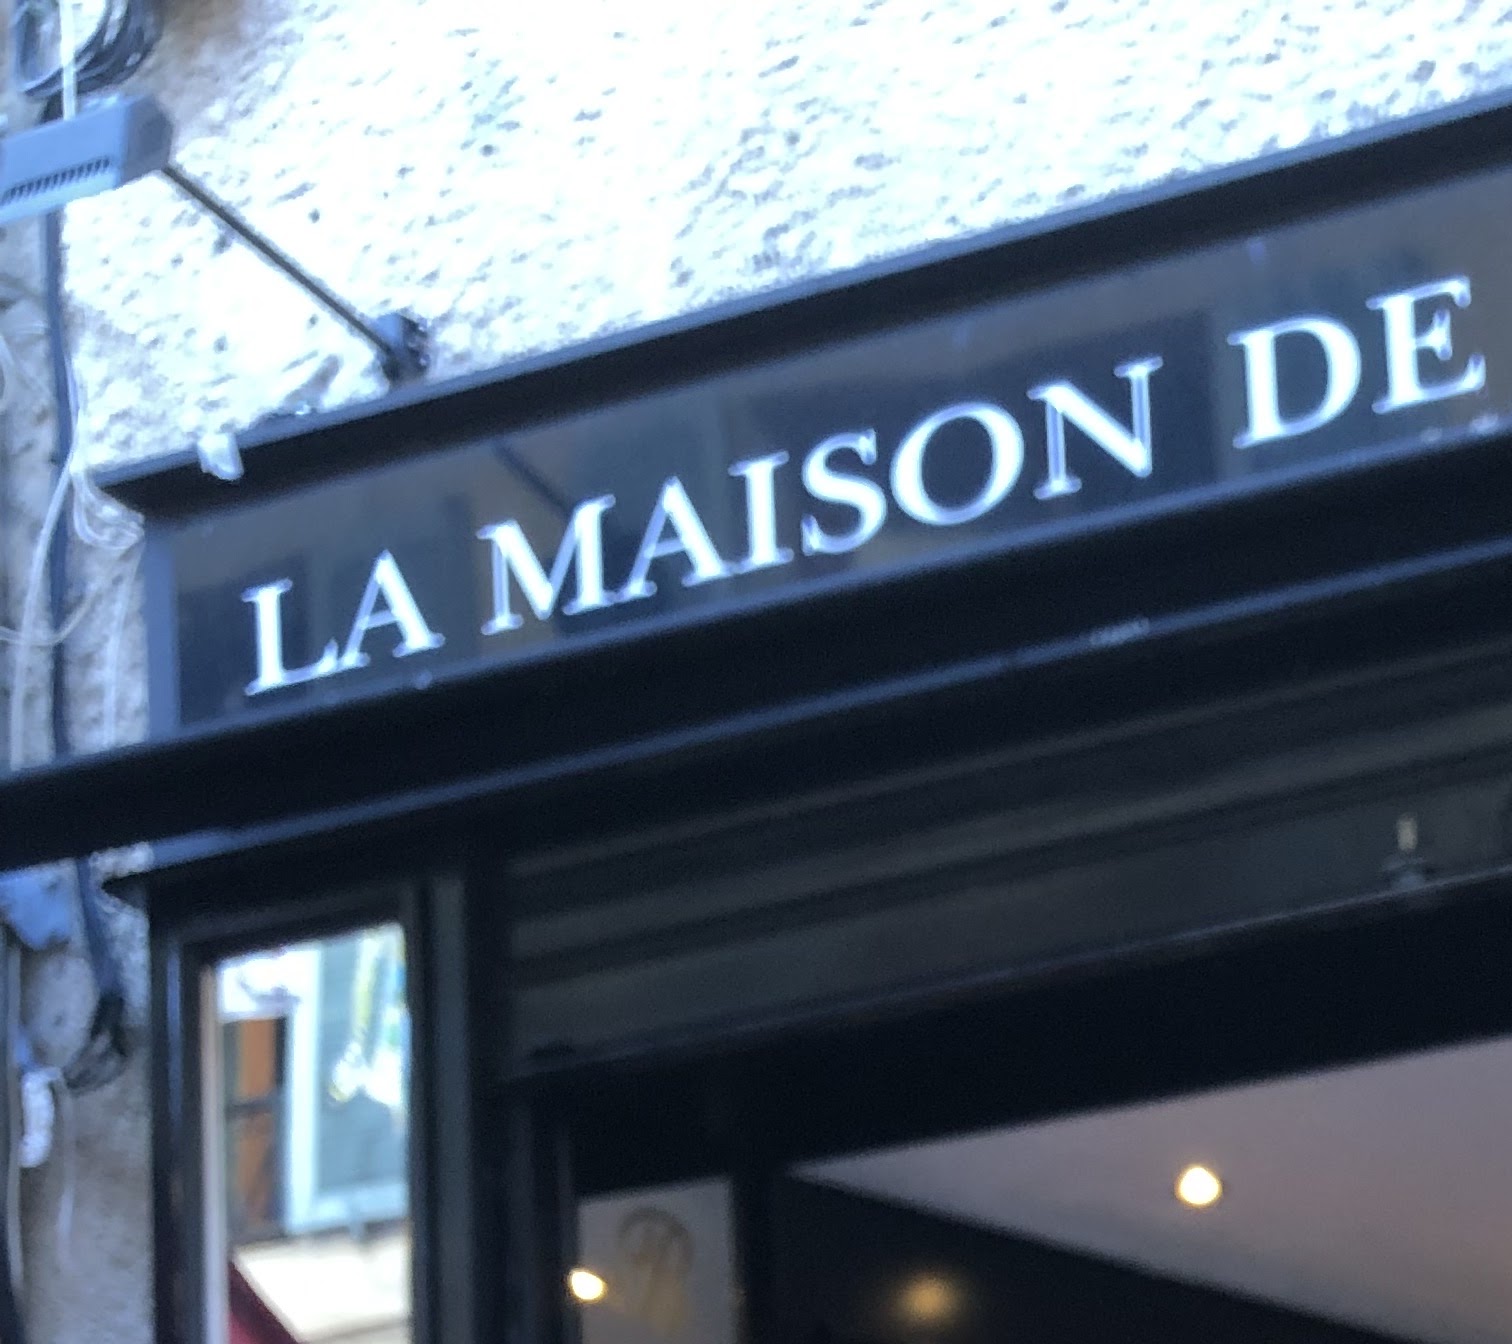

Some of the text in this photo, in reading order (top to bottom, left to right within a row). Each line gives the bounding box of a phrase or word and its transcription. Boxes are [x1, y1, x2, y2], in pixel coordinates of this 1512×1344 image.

[242, 547, 445, 697] LA
[476, 354, 1167, 638] MAISON
[1226, 274, 1486, 449] DE
